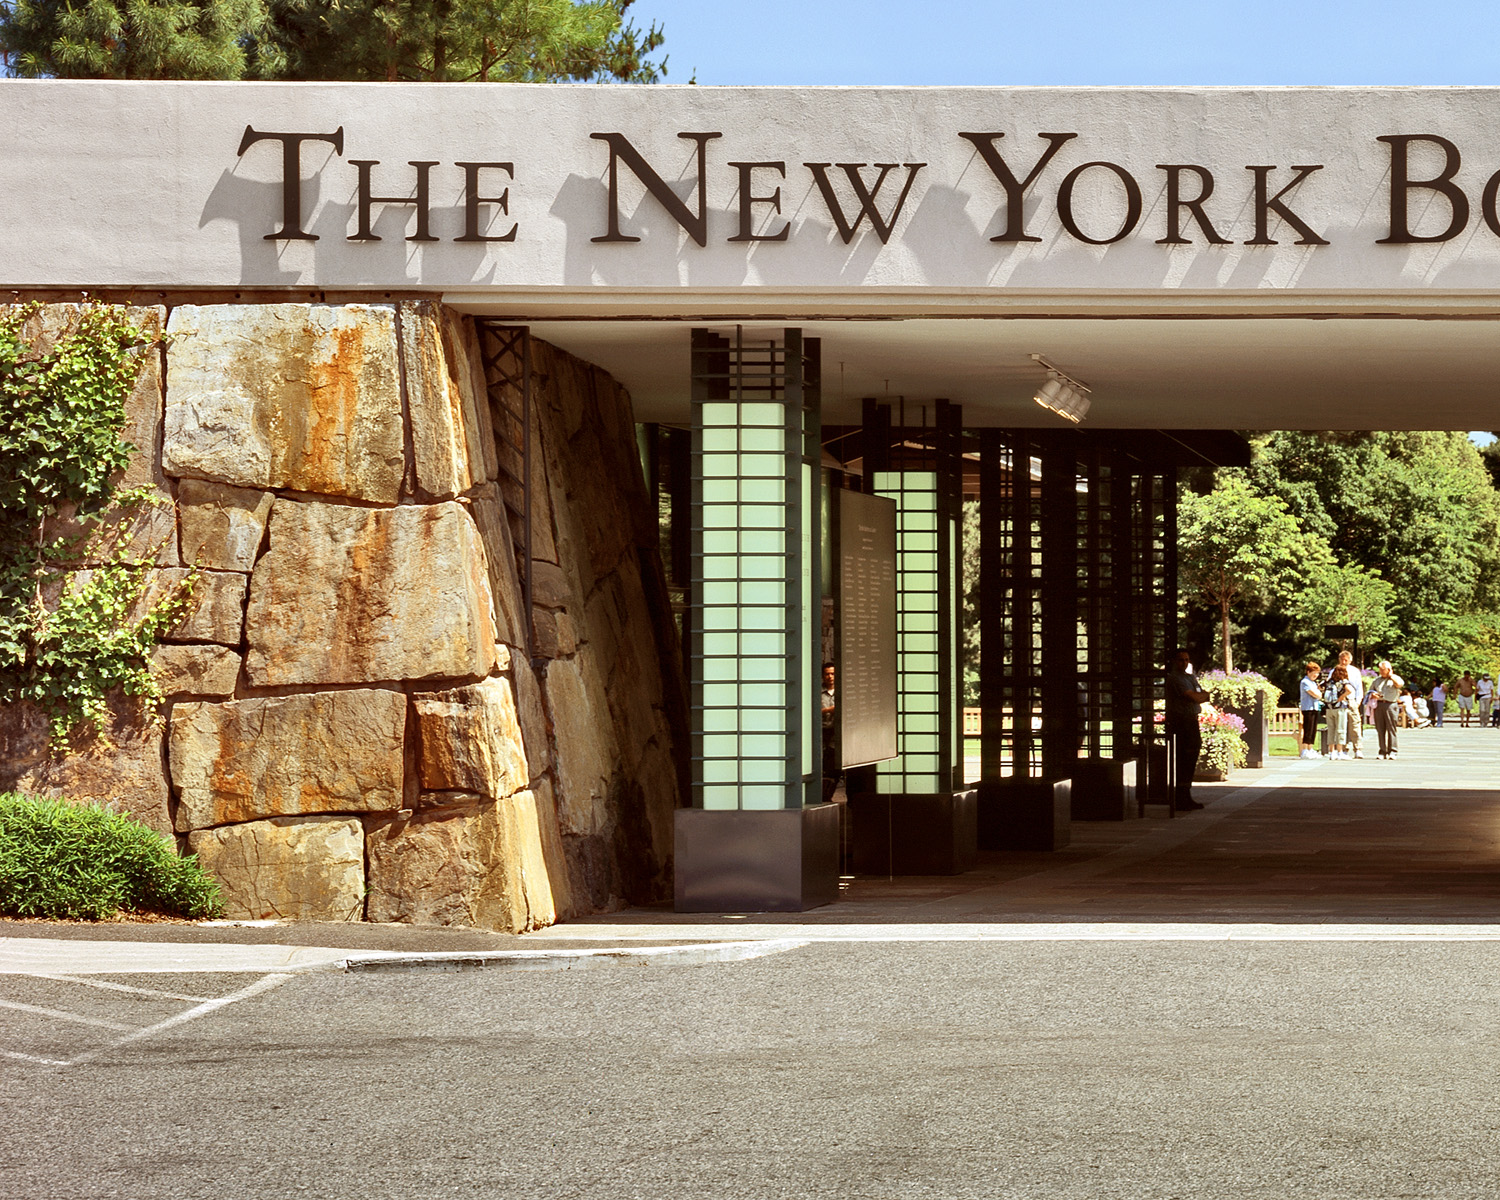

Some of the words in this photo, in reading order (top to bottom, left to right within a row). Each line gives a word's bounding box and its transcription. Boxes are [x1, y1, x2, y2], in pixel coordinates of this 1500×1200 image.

[238, 125, 519, 243] THE
[590, 132, 928, 247] NEW
[958, 132, 1331, 246] YORK
